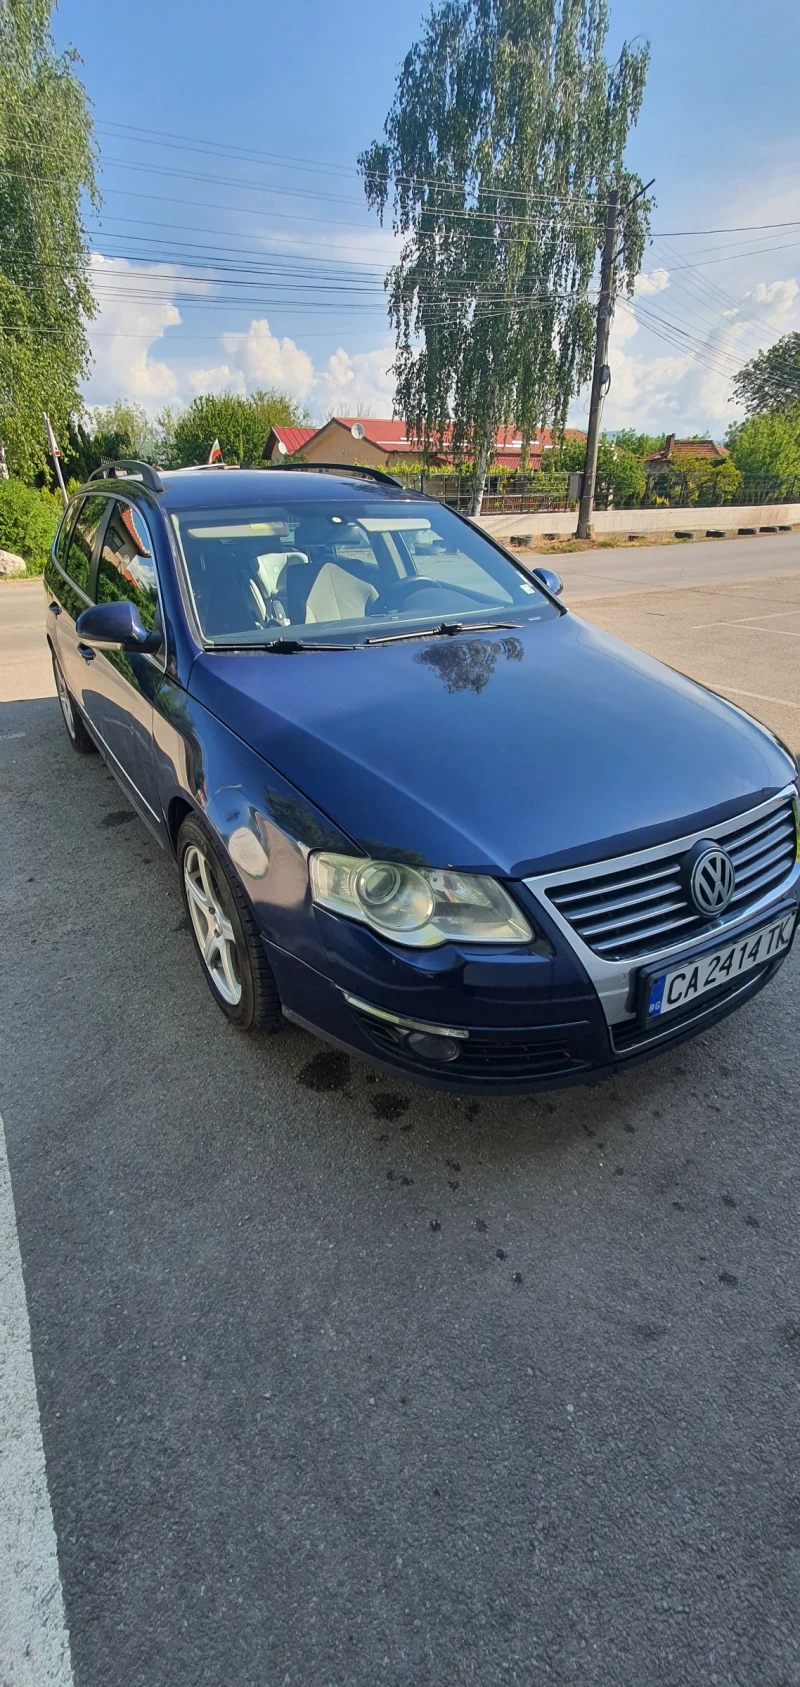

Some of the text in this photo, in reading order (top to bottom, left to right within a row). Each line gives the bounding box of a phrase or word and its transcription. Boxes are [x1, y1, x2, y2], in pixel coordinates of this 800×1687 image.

[666, 917, 792, 1005] CA 2414 TK
[648, 1001, 662, 1012] BG
